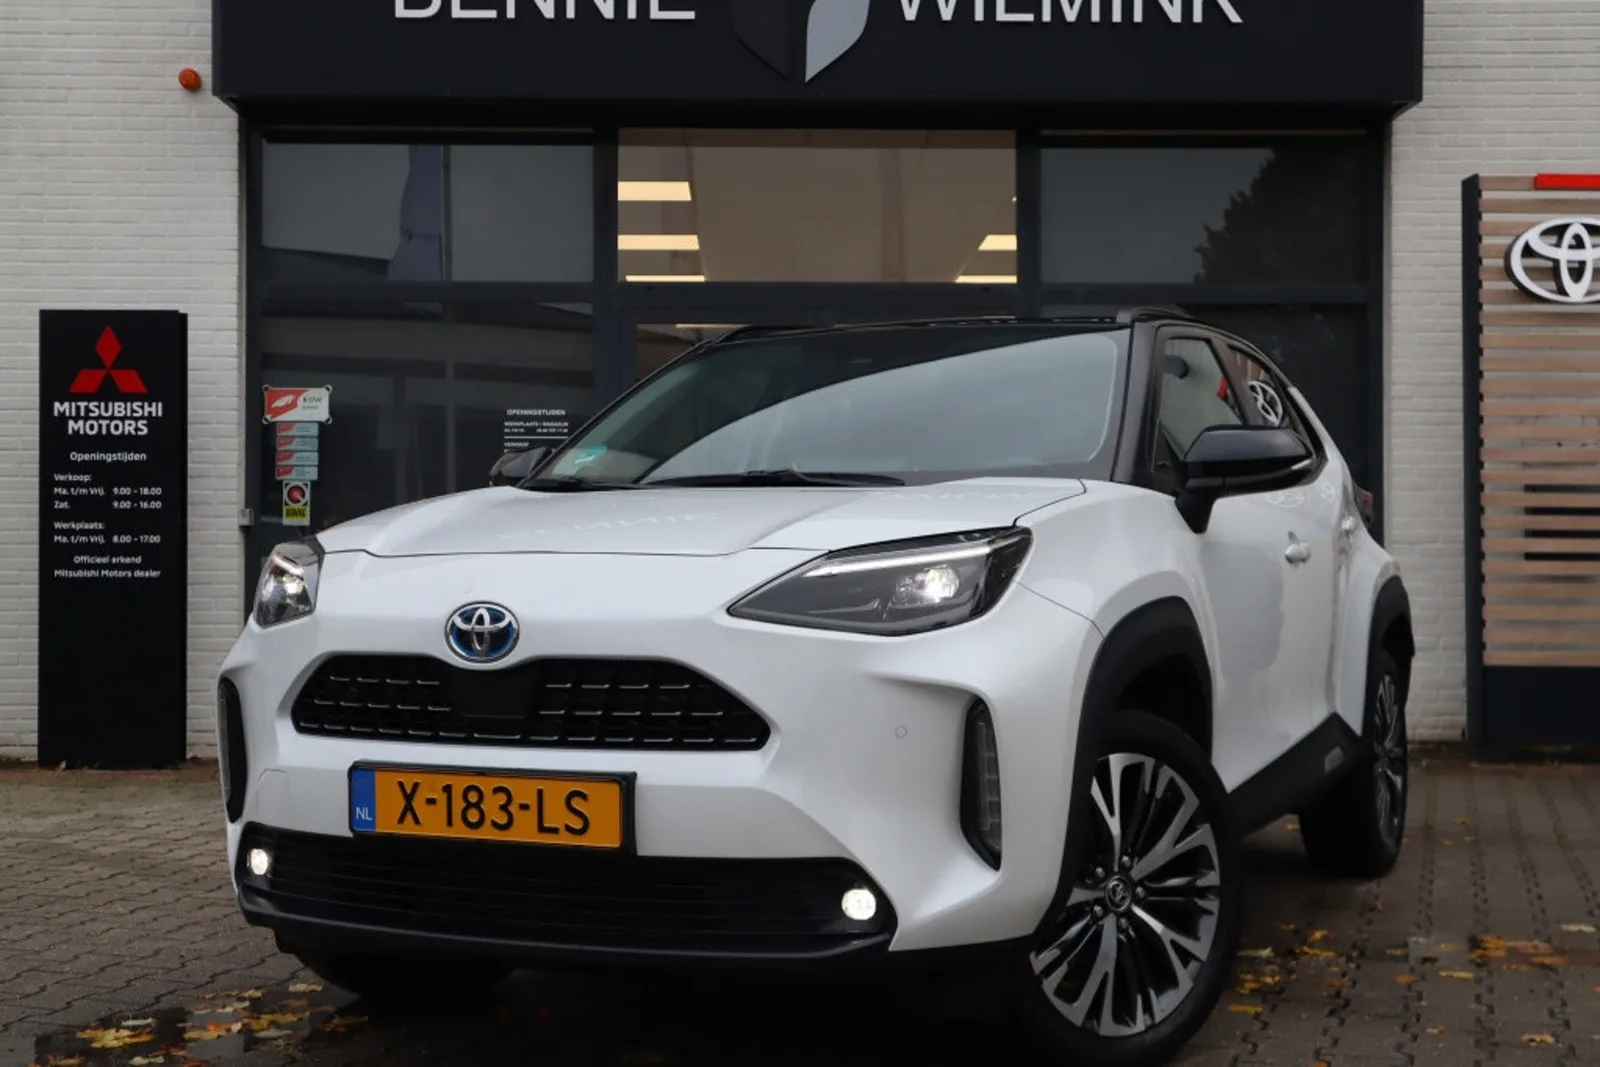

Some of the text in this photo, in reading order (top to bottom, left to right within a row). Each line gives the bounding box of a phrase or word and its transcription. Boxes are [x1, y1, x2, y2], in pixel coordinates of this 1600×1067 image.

[53, 401, 163, 417] MITSUBISHI
[67, 419, 149, 436] MOTORS
[69, 451, 147, 463] Openingstijden
[53, 473, 92, 483] Verkoop:
[70, 486, 88, 496] t/m
[112, 486, 132, 495] 9.00
[139, 486, 162, 495] 18.00
[53, 500, 70, 509] Zat.
[112, 500, 132, 509] 9.00
[139, 500, 162, 509] 16.00
[53, 521, 105, 531] Werkplaats:
[70, 534, 88, 544] t/m
[112, 534, 132, 543] 8.00
[139, 534, 161, 543] 17.00
[73, 555, 142, 564] Officieel erkend
[54, 569, 161, 578] Mitsubishi Motors dealer
[355, 779, 591, 837] NL X-183-LS
